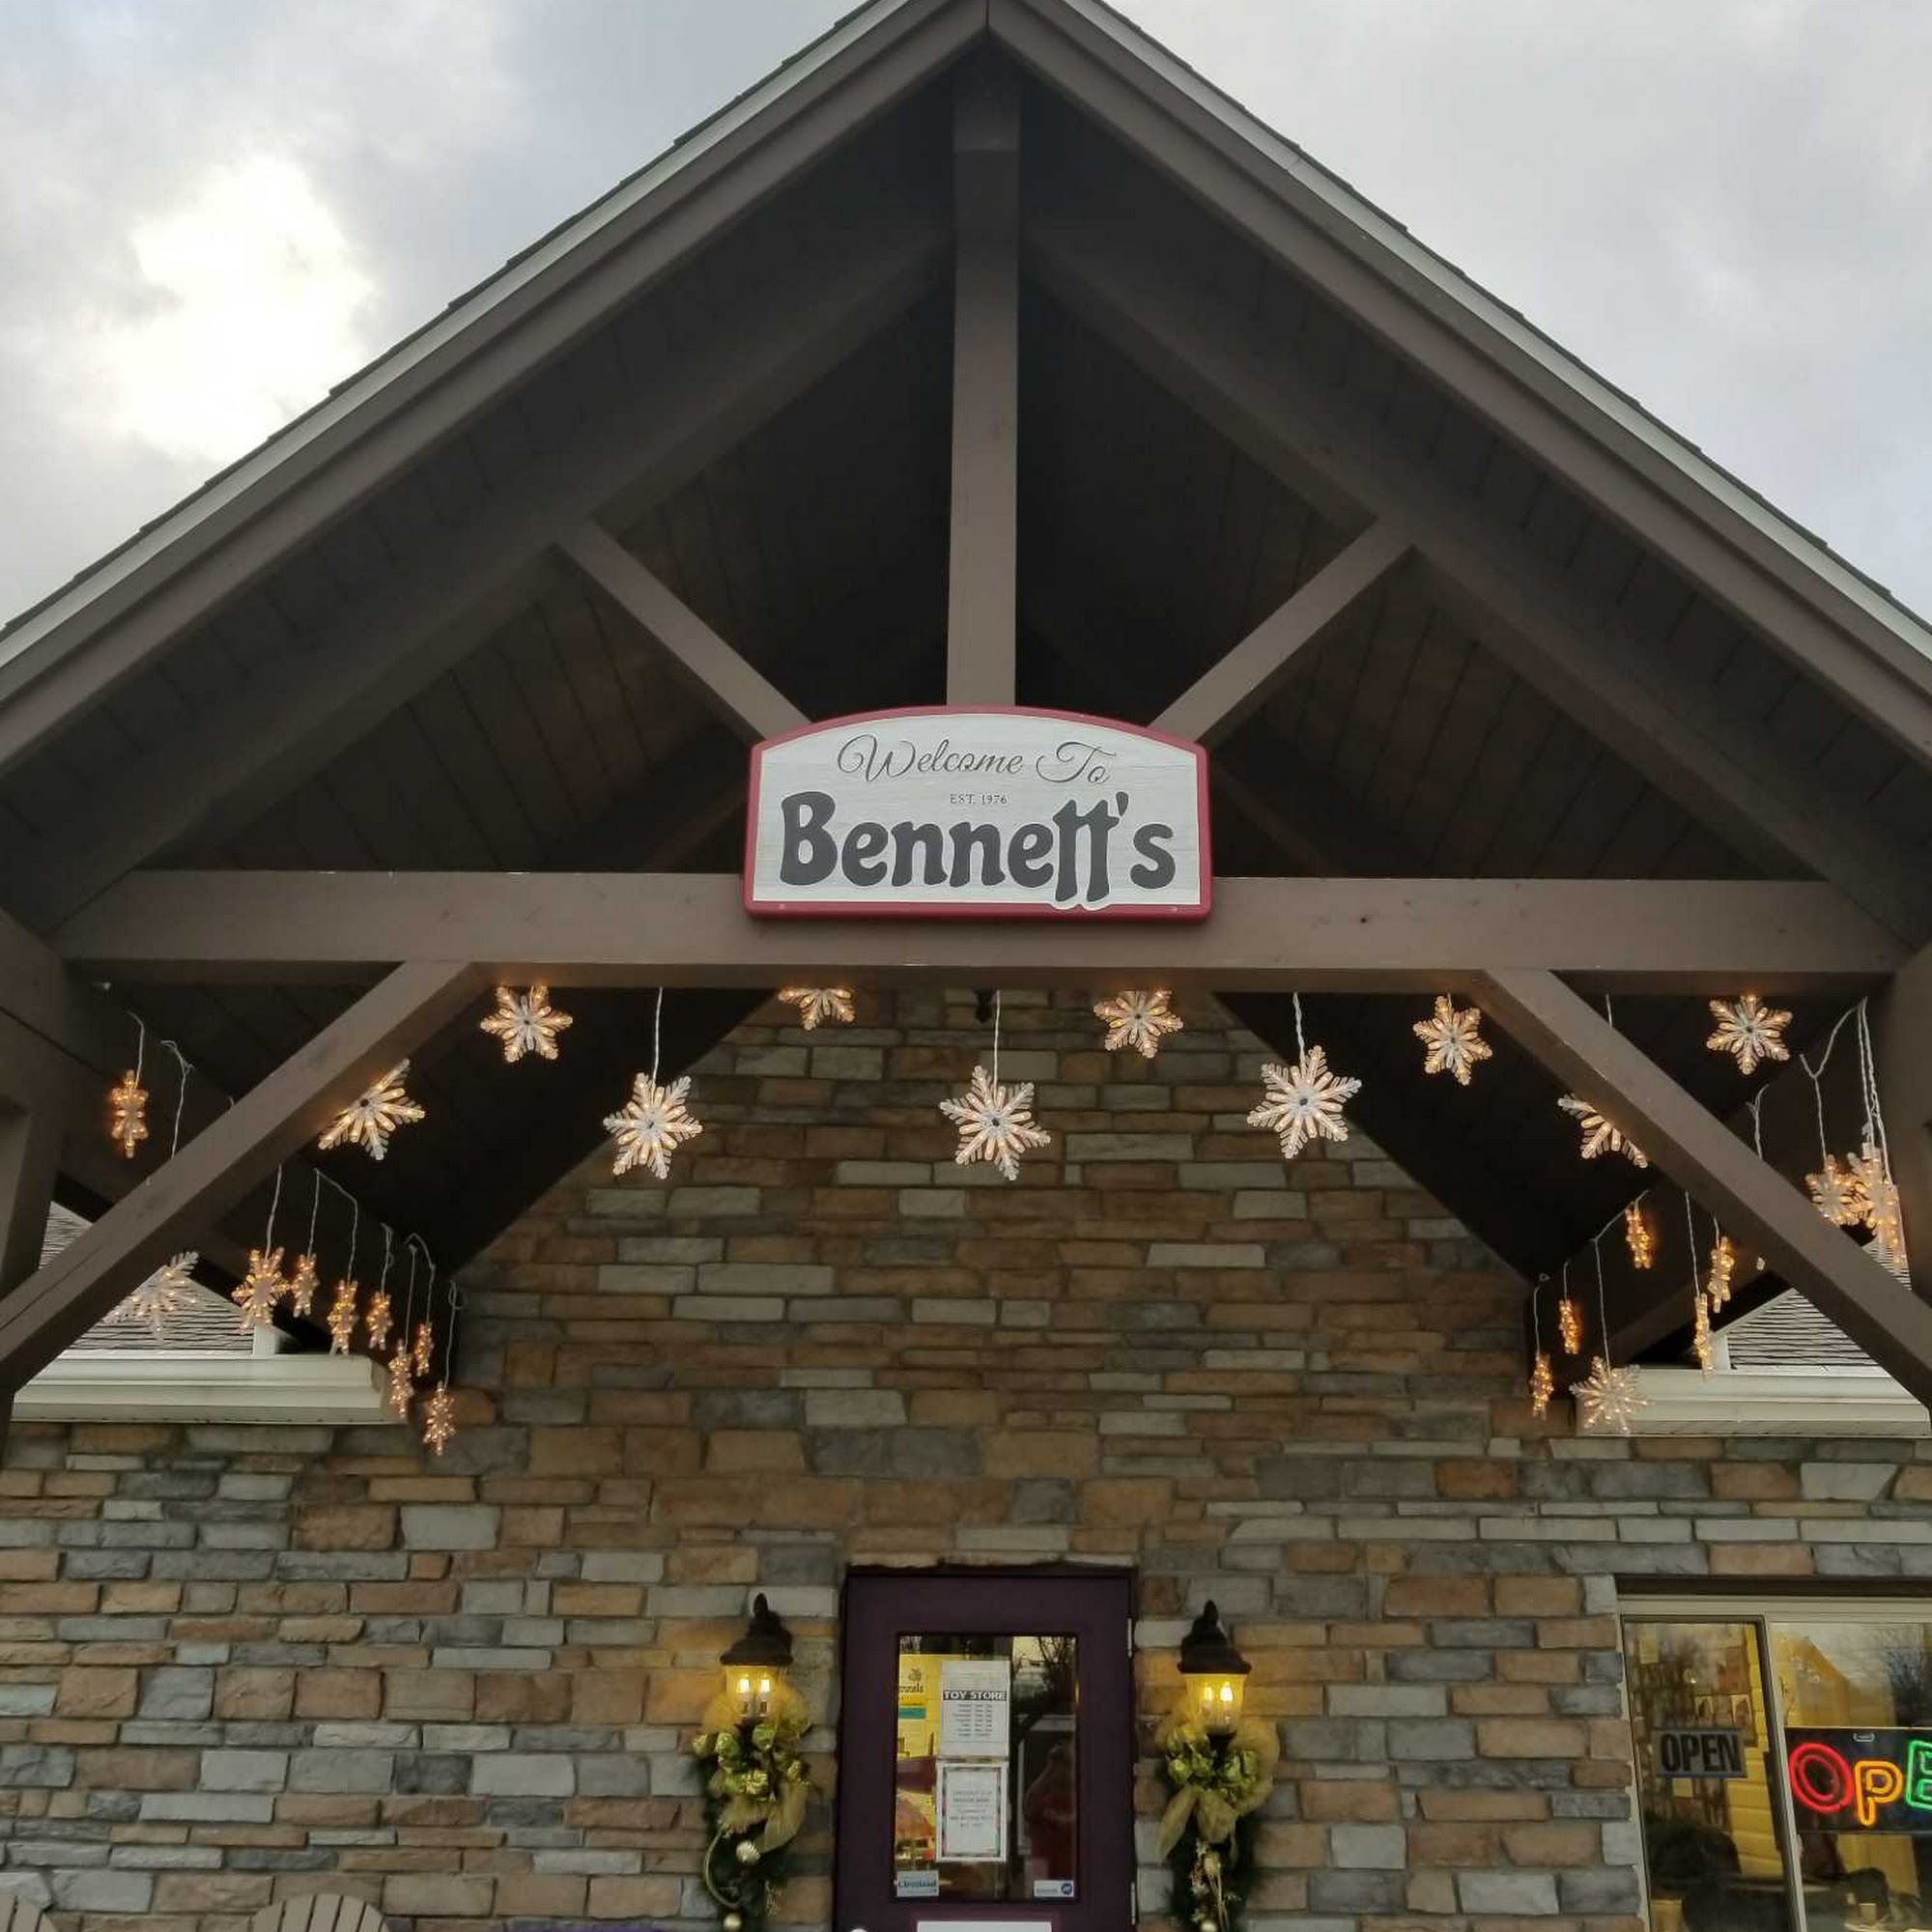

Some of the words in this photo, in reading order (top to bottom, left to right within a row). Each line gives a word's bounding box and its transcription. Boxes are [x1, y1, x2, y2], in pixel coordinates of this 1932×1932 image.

[837, 733, 1024, 782] Welcome
[1035, 740, 1117, 784] To
[980, 794, 1008, 805] 1976
[779, 790, 1177, 903] Bennett's
[944, 1690, 967, 1700] TOY
[970, 1690, 1007, 1700] STORE
[1661, 1733, 1742, 1772] OPEN
